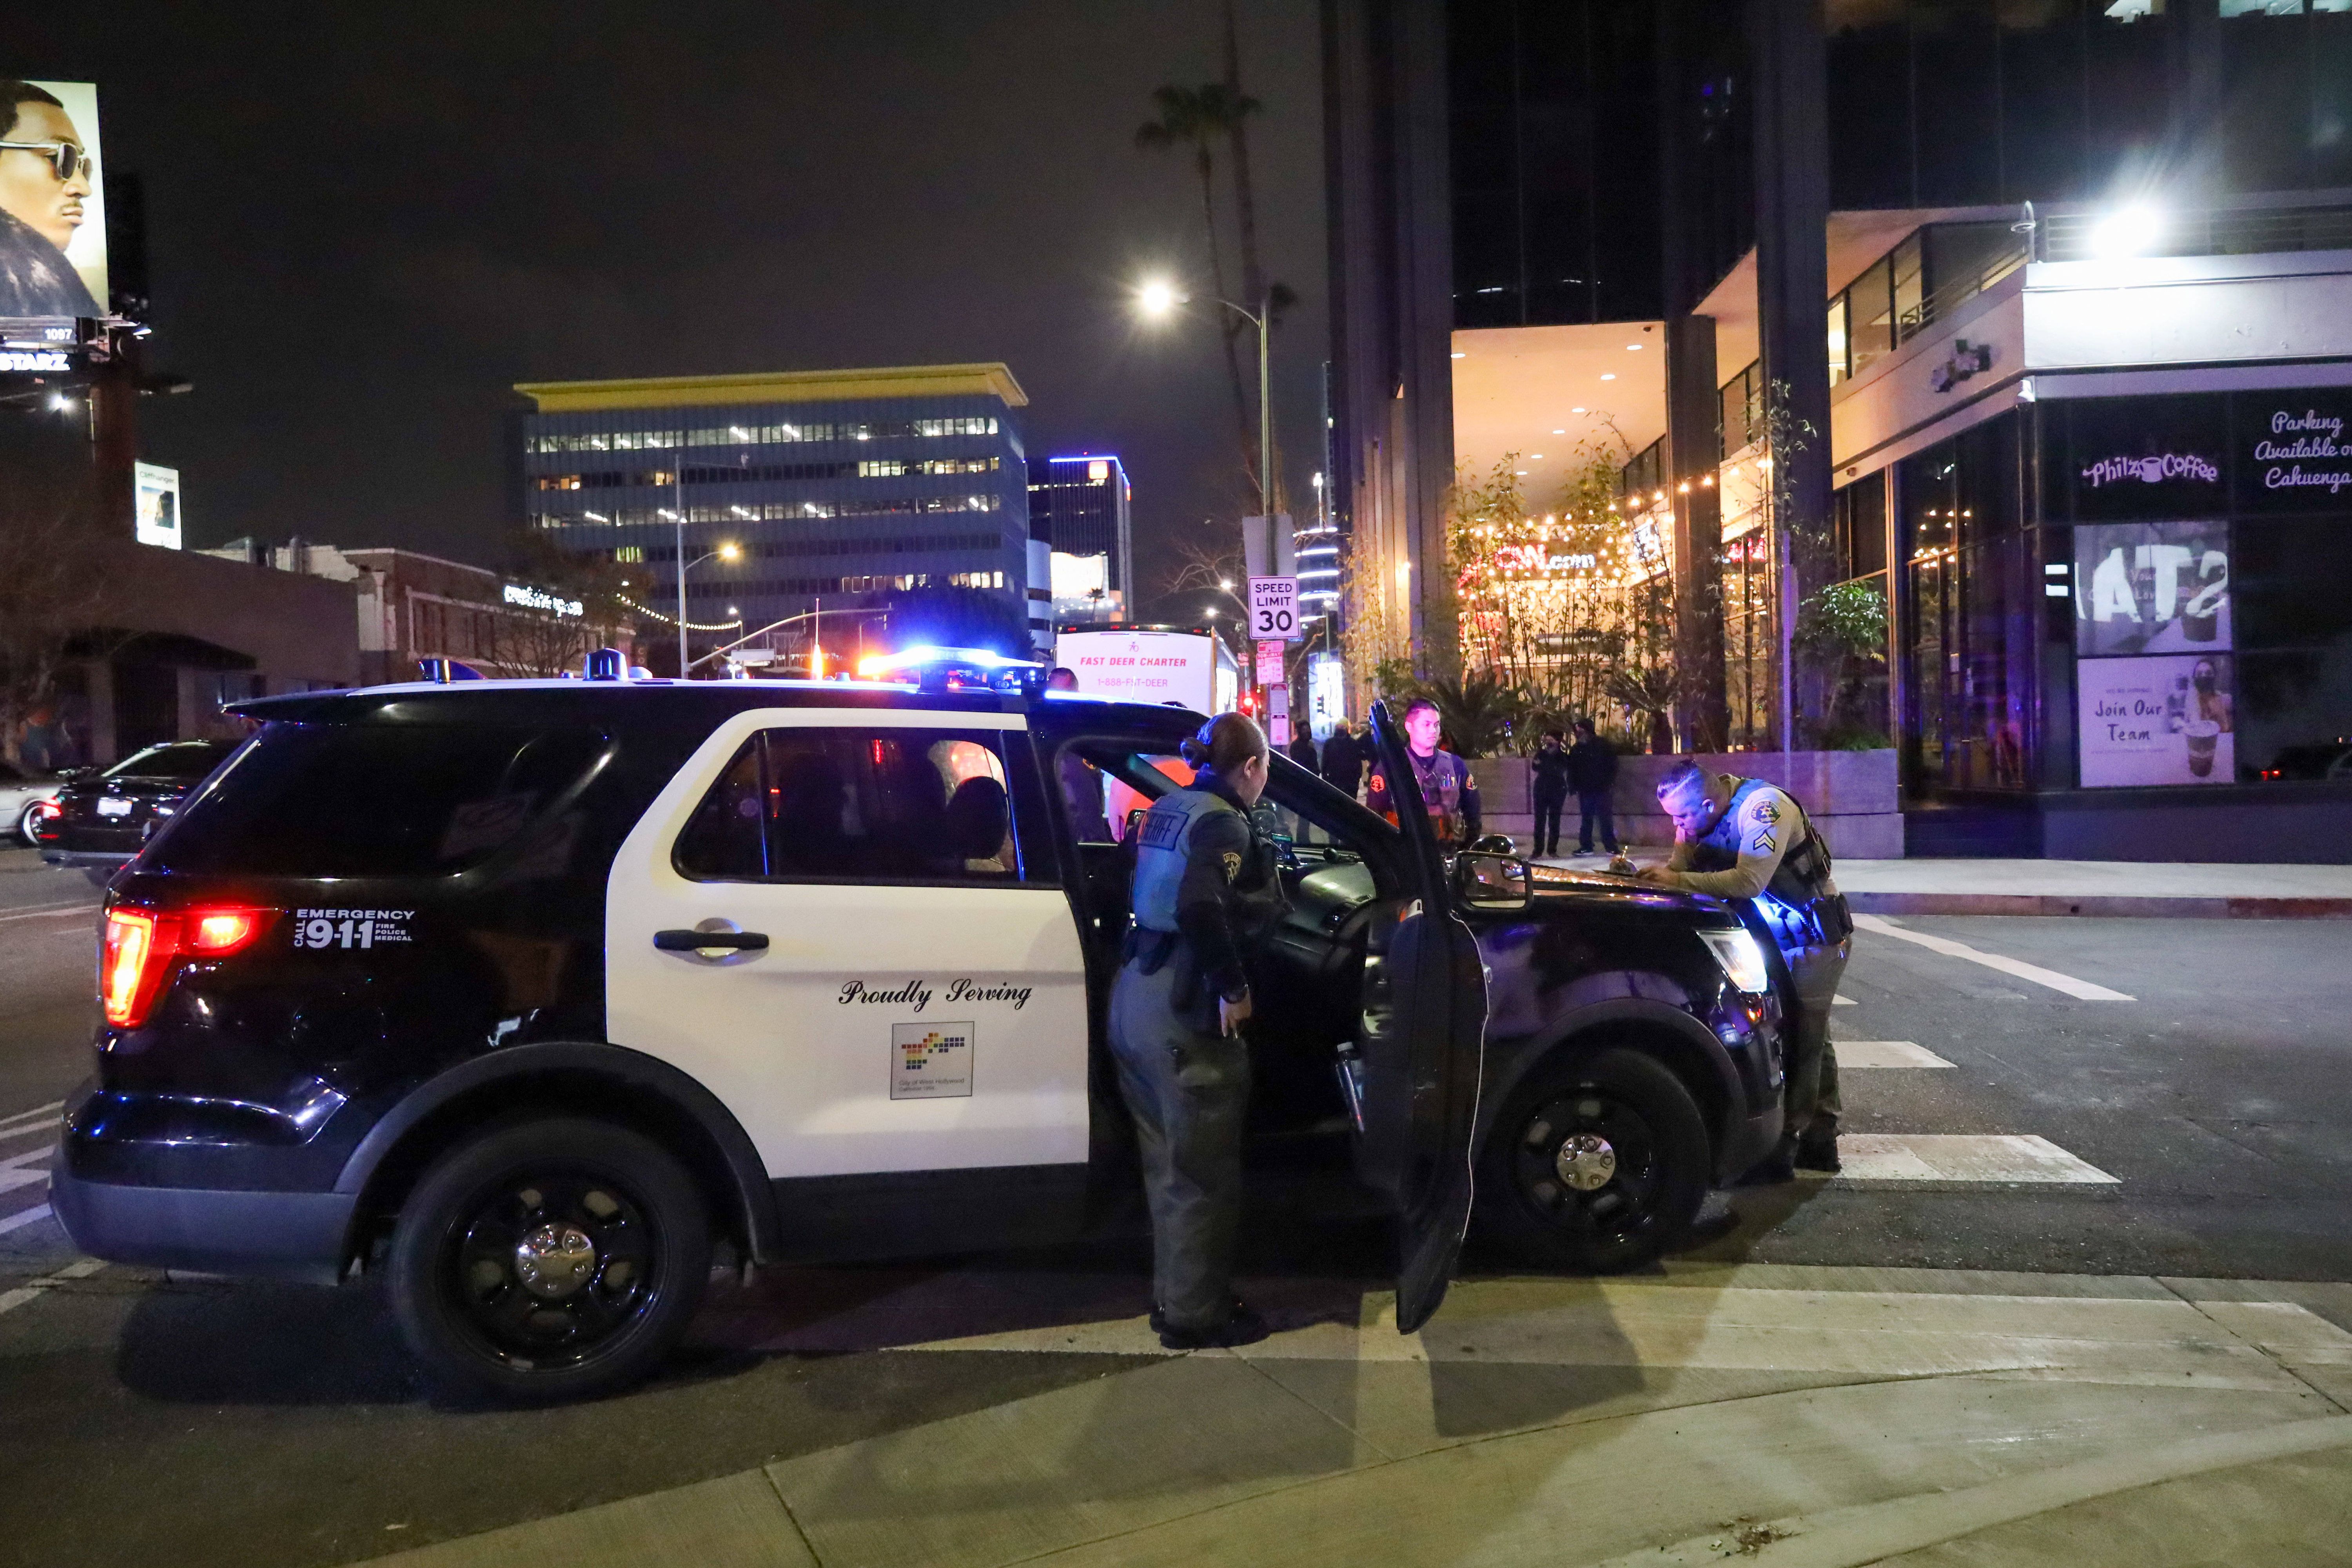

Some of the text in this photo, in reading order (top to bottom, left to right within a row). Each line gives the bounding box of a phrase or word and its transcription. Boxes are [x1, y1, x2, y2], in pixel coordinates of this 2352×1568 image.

[45, 328, 73, 340] 1097
[0, 353, 71, 371] STARZ
[2272, 410, 2343, 438] Parking
[2255, 436, 2338, 460] Available
[2082, 454, 2218, 487] Philz Coffee
[2265, 465, 2352, 493] Cahuenga
[1255, 584, 1292, 593] SPEED
[1257, 597, 1291, 606] LIMIT
[1258, 610, 1292, 632] 30
[1080, 657, 1105, 665] FAST
[1140, 658, 1187, 666] CHARTER
[1098, 678, 1168, 687] 1-888-FST-DEER
[2096, 699, 2162, 717] Join Our
[2107, 724, 2150, 741] Team
[296, 909, 415, 920] EMERGENCY
[294, 920, 306, 947] CALL
[306, 919, 374, 948] 9-1-1
[838, 978, 1033, 1013] Proudly Serving
